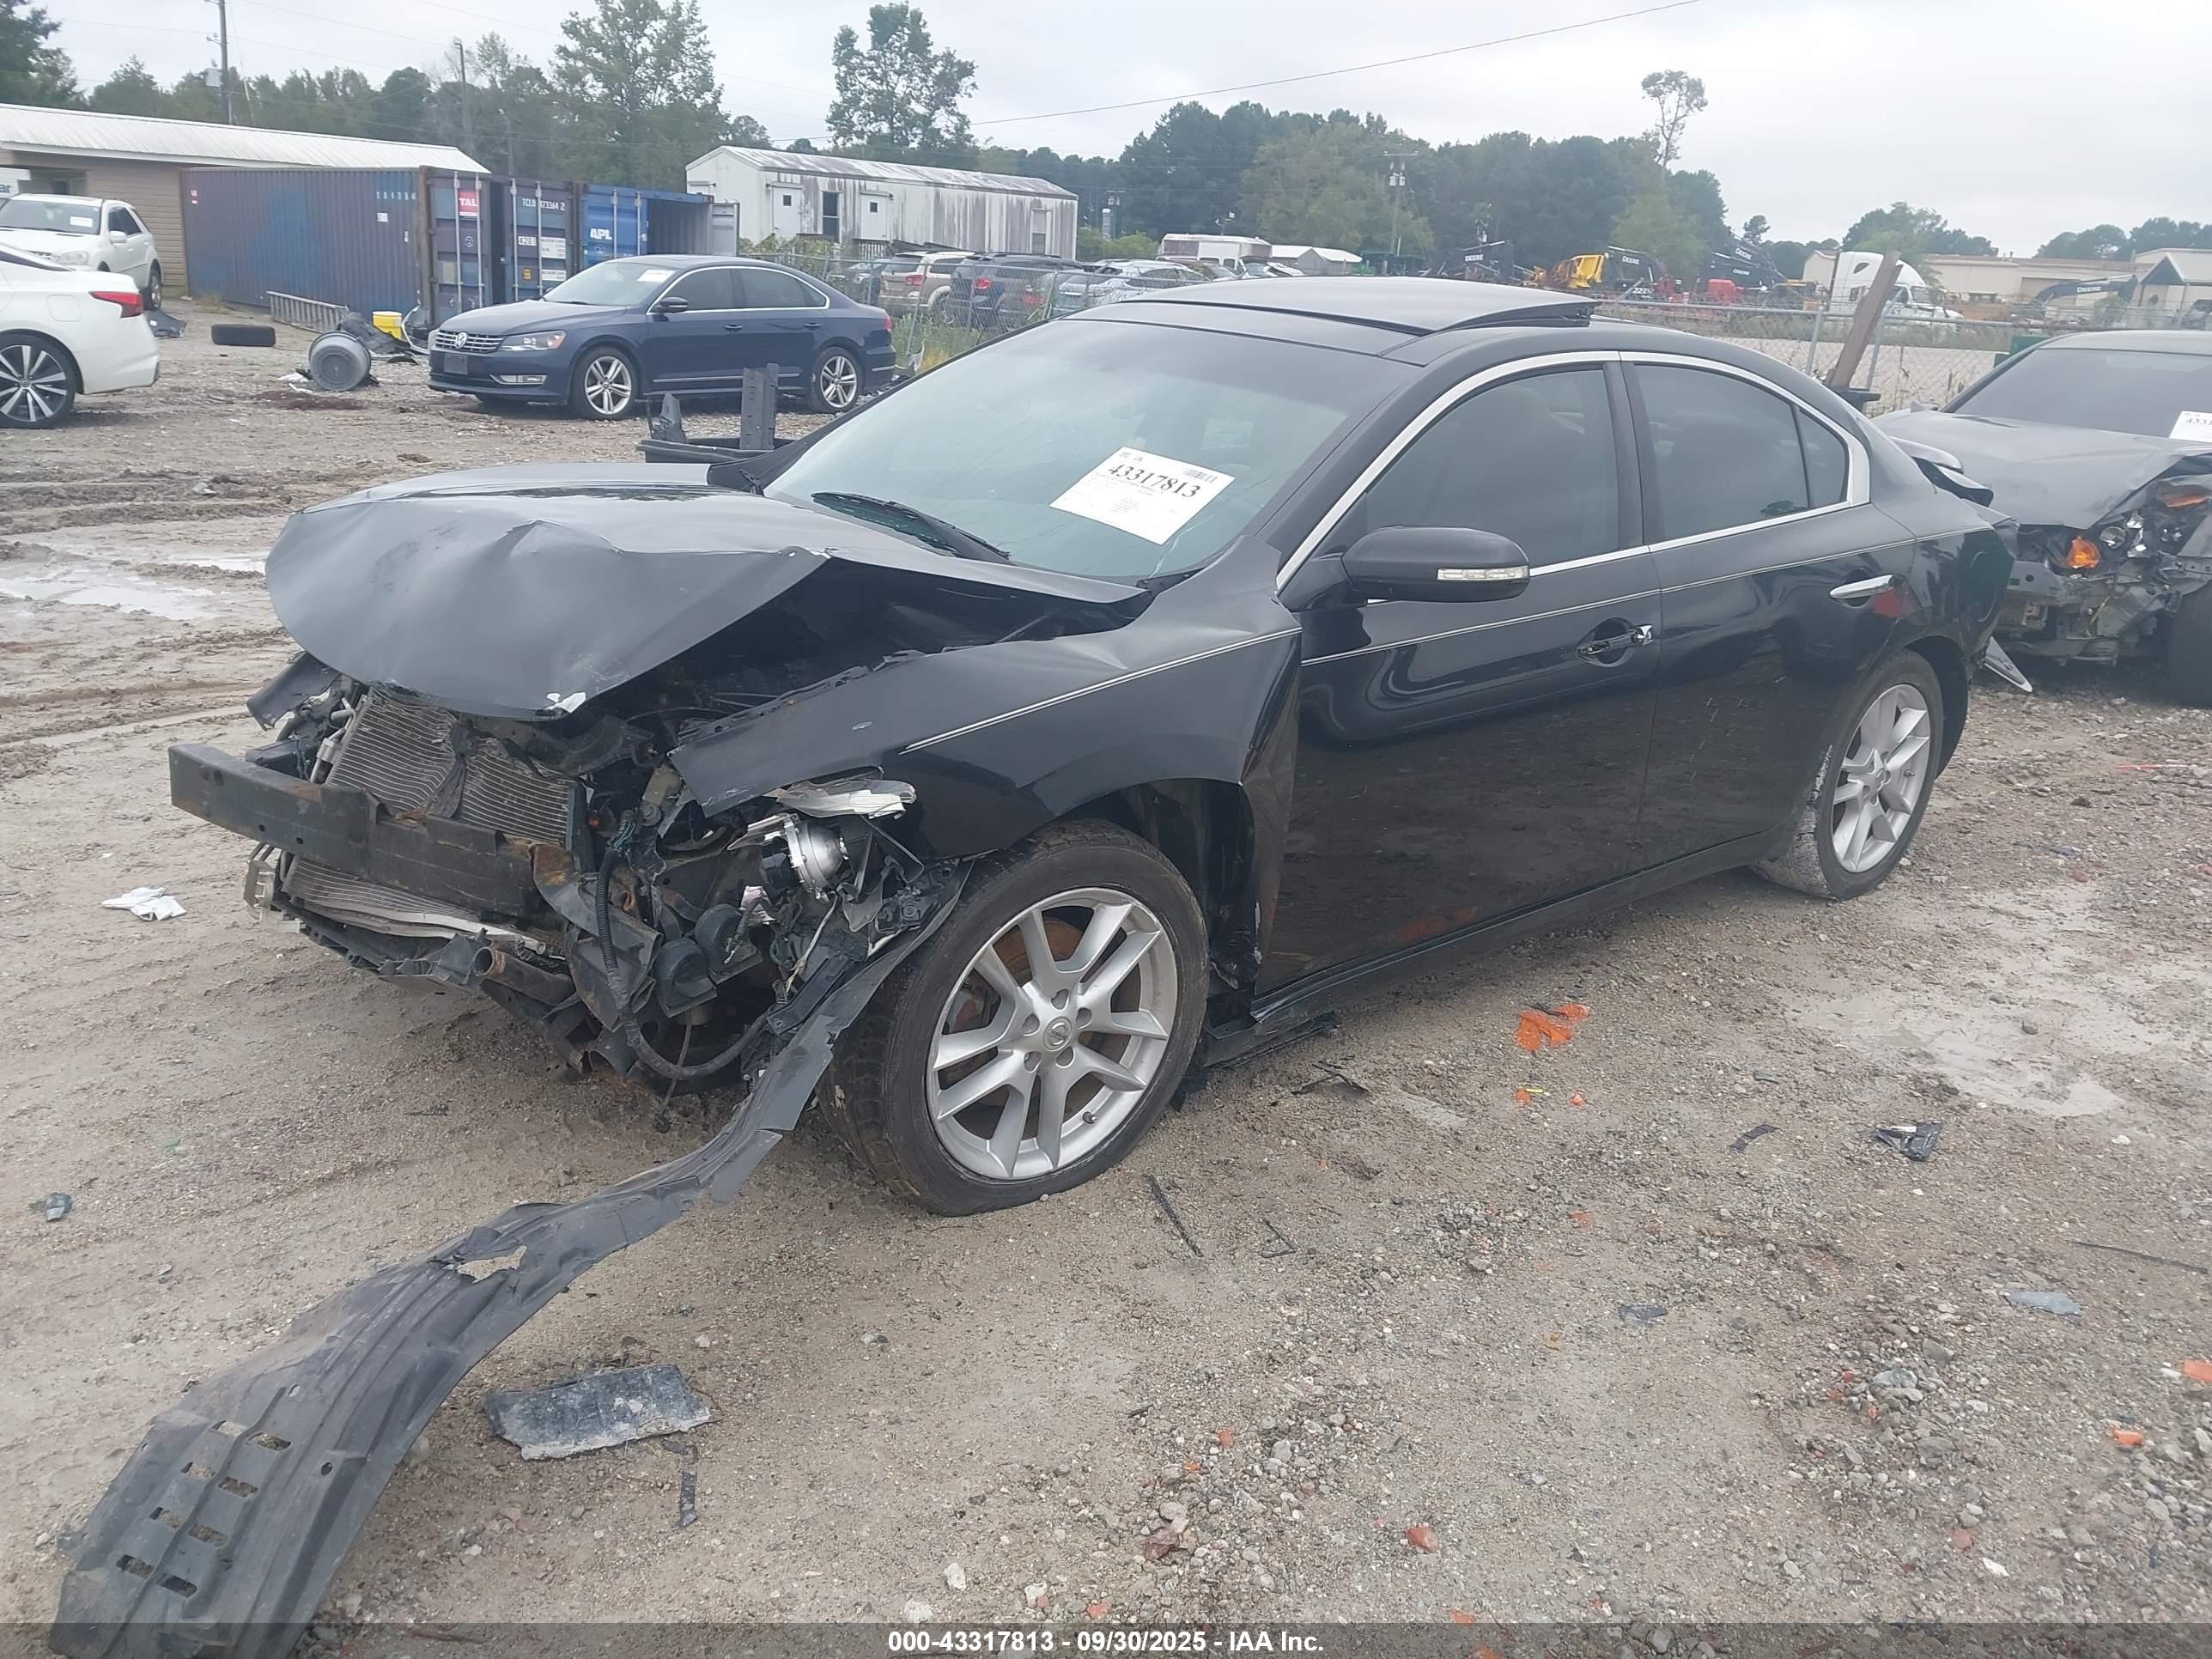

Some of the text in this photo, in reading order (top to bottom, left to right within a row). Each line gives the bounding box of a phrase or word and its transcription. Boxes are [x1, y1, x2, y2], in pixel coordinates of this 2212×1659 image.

[459, 198, 478, 207] TAL
[590, 228, 612, 240] APL
[1622, 256, 1640, 265] DEERE
[1108, 465, 1201, 498] 43317813
